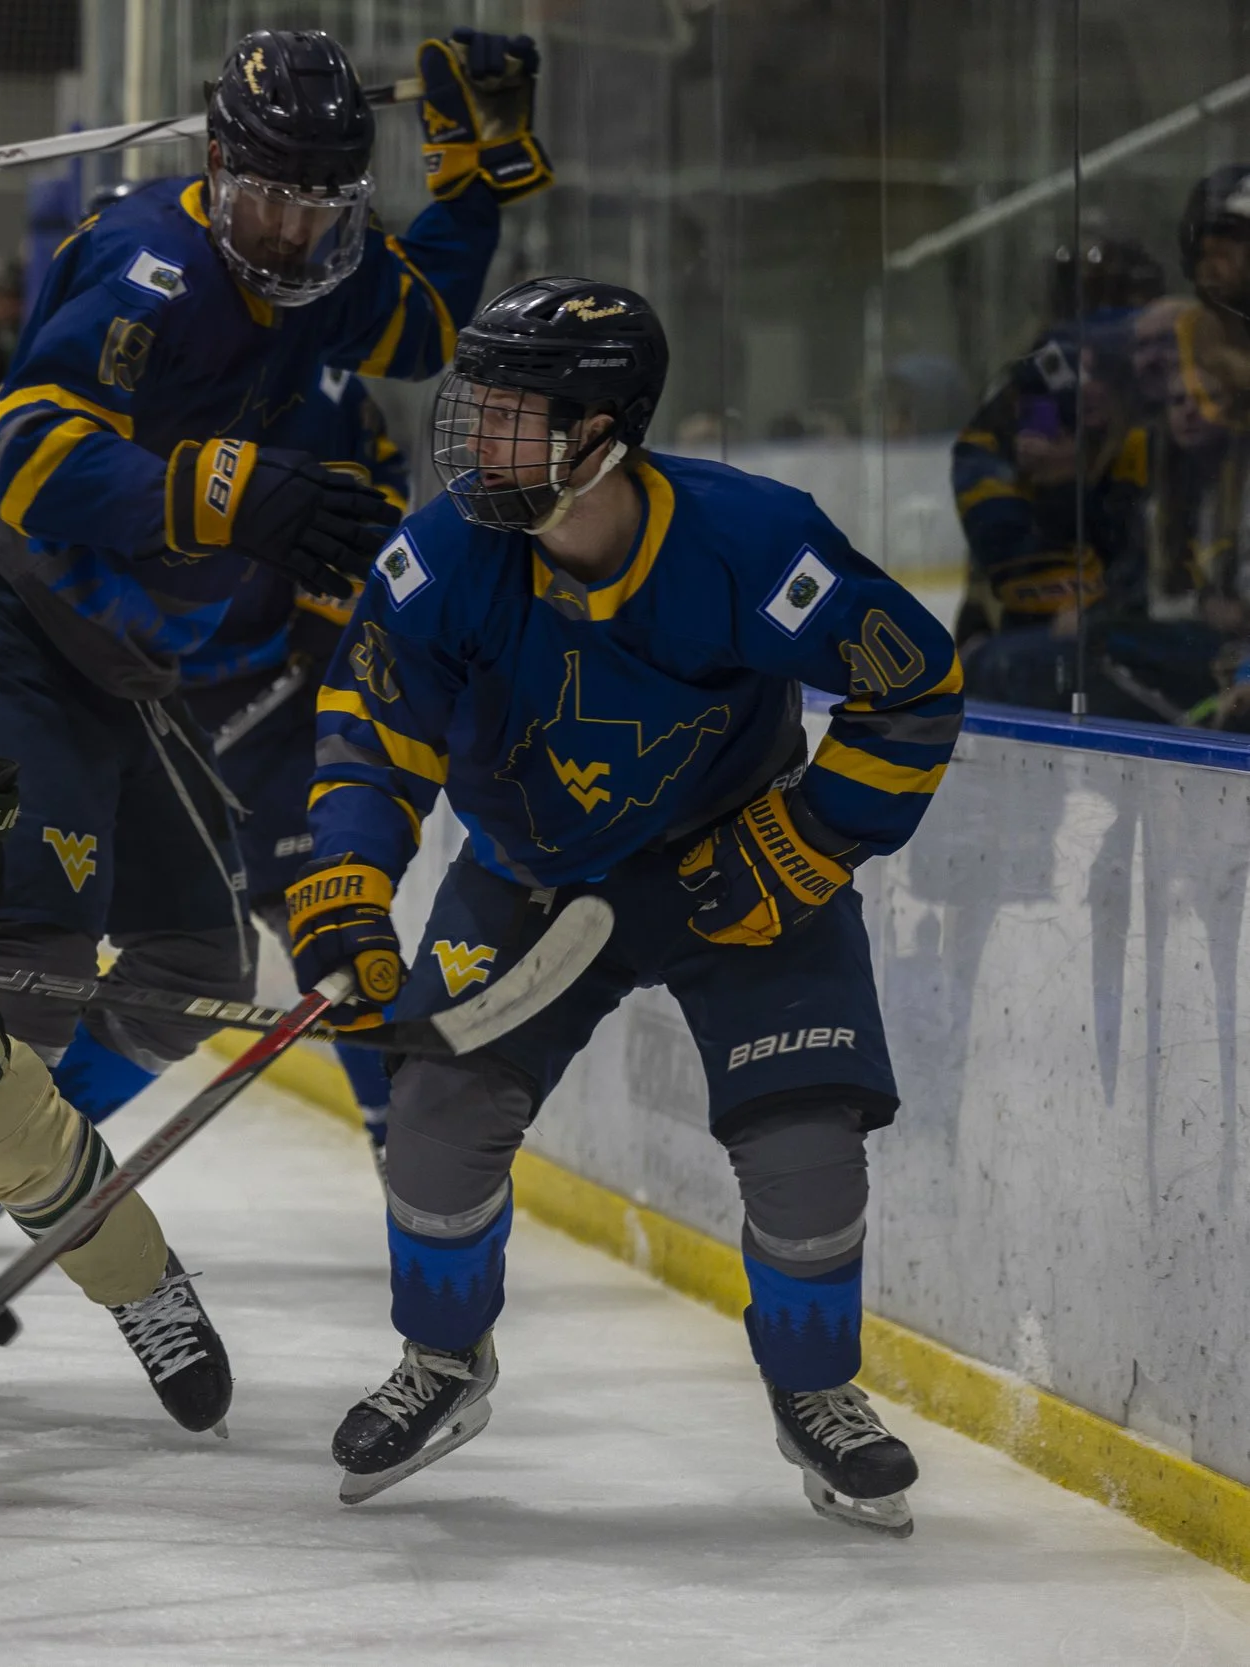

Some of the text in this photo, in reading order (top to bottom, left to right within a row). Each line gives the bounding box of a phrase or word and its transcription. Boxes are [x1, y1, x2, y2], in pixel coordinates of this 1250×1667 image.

[577, 358, 629, 368] BAUER
[749, 799, 839, 900] WARRIOR
[726, 1026, 857, 1074] BAUER
